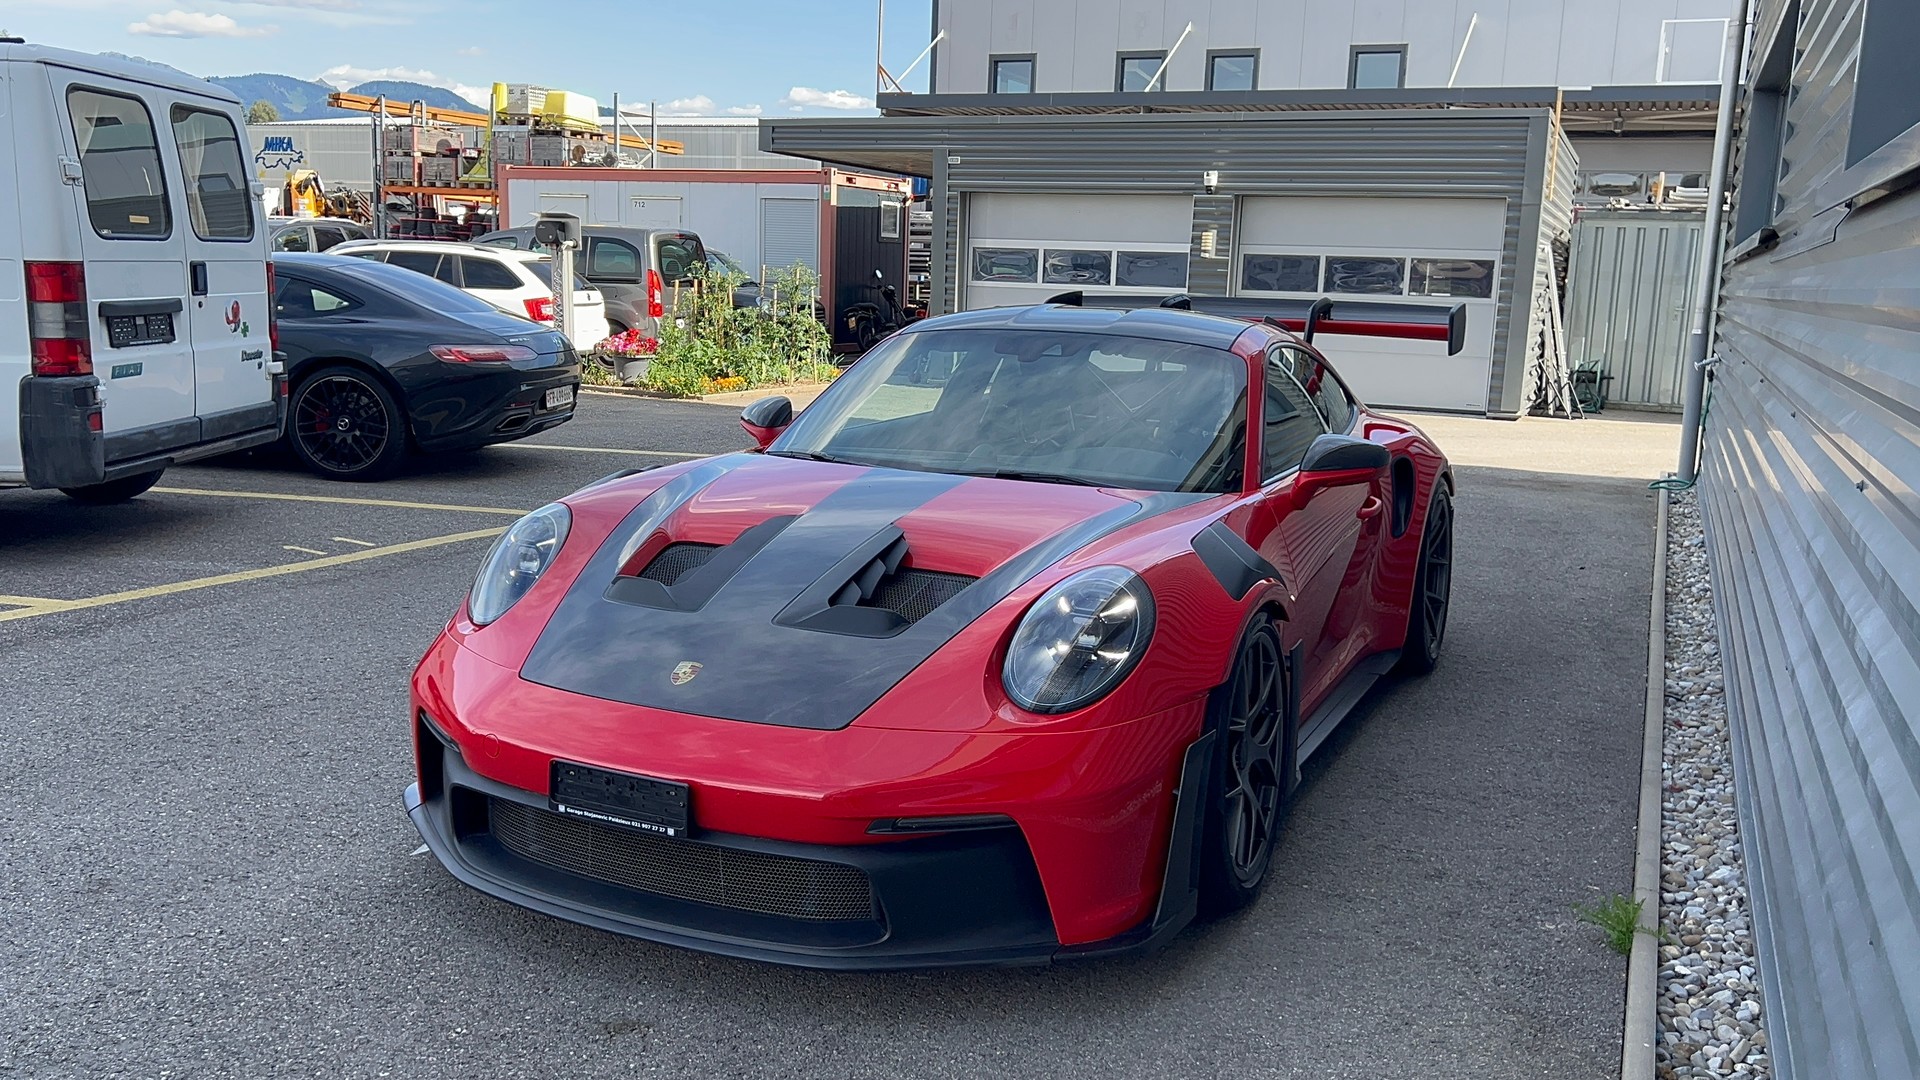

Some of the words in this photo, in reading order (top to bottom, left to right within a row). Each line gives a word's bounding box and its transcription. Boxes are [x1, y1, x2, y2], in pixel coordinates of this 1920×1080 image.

[264, 136, 293, 151] MIKA
[115, 364, 141, 376] FIAT
[566, 807, 583, 815] Garage
